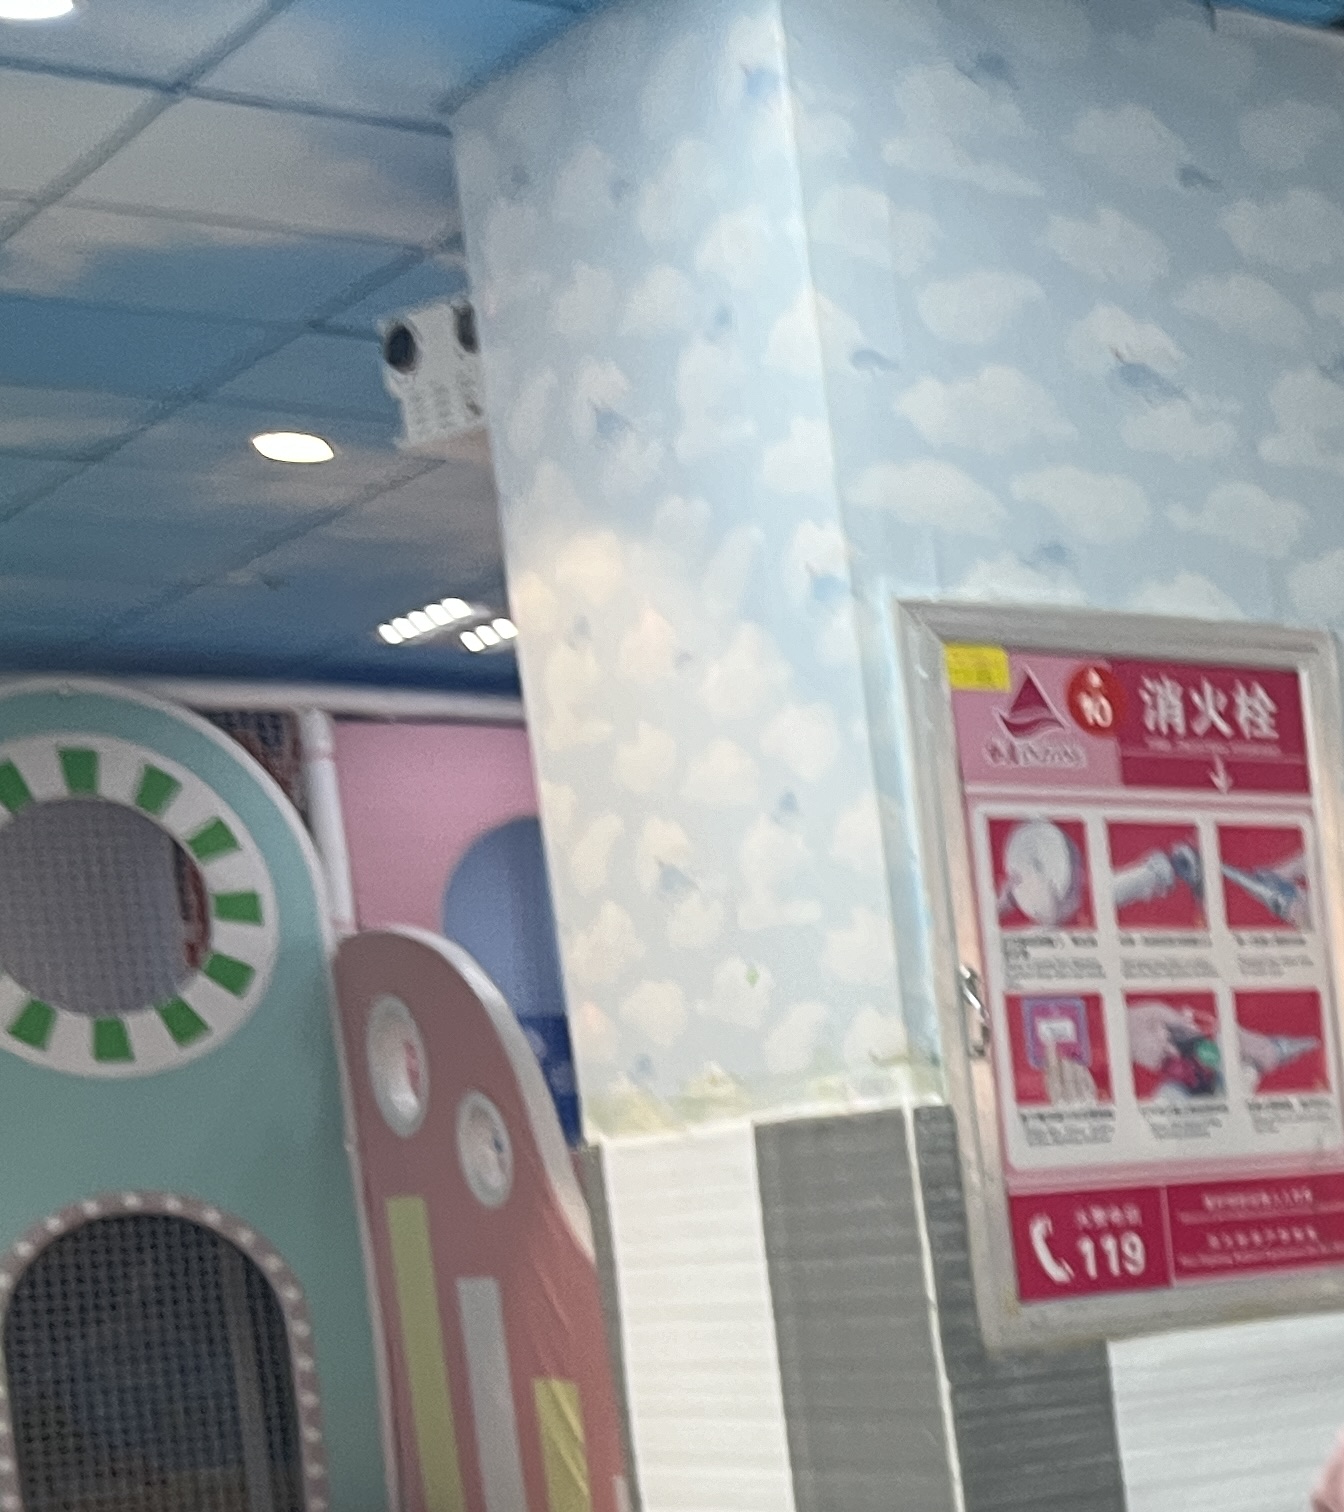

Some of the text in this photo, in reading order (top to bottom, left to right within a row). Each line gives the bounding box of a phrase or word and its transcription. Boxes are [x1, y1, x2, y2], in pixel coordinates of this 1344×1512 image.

[1139, 672, 1280, 740] 消火栓
[1076, 1231, 1147, 1281] 119
